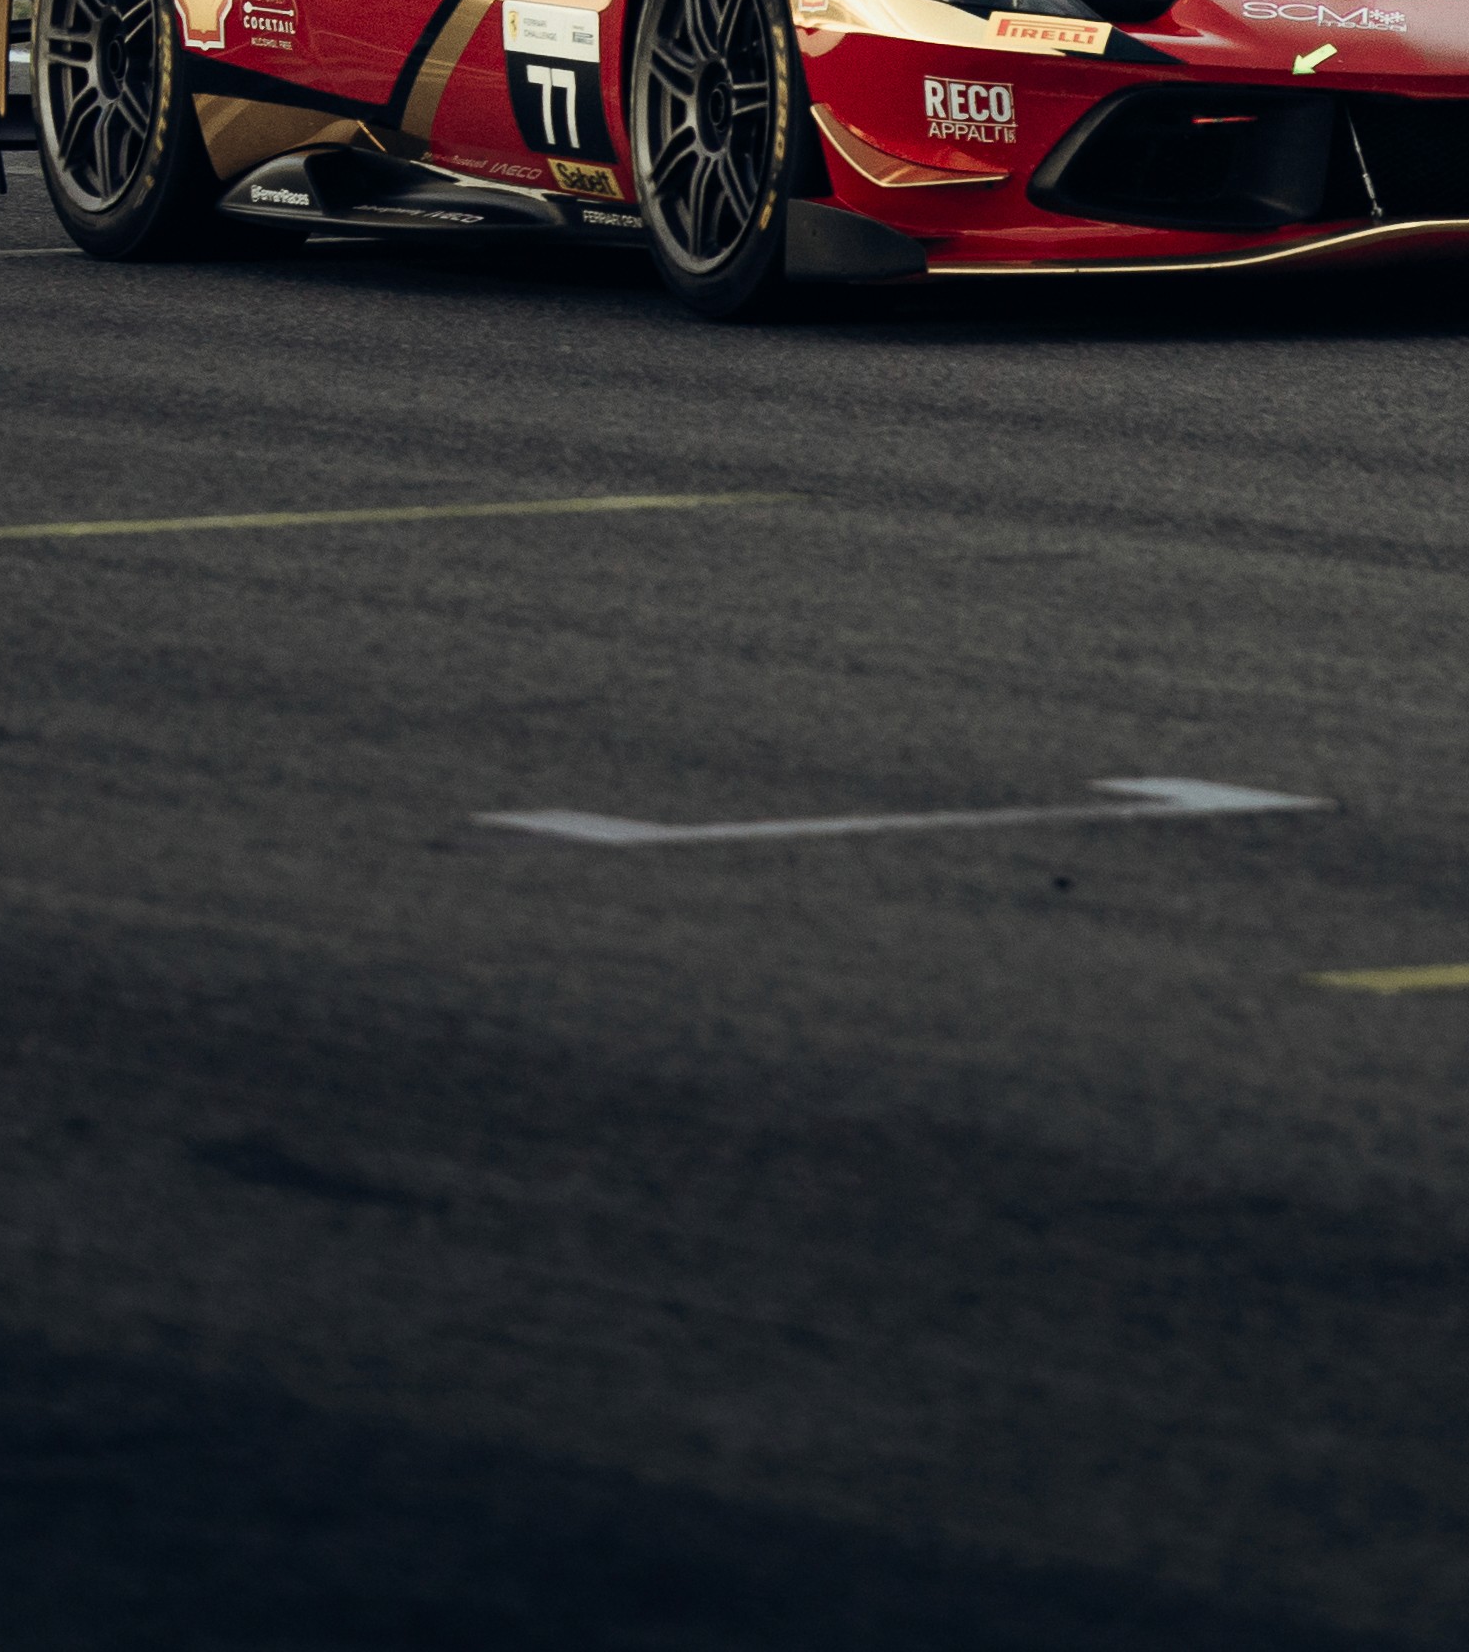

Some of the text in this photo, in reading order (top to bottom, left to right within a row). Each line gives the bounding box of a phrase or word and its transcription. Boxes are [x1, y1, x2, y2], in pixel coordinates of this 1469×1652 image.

[243, 15, 296, 34] COCKTAIL
[1243, 1, 1369, 26] SCM
[1318, 18, 1407, 33] medical
[997, 19, 1099, 45] PIRELLI
[526, 64, 580, 149] 77
[924, 79, 1012, 123] RECO
[556, 162, 617, 197] Sabelt
